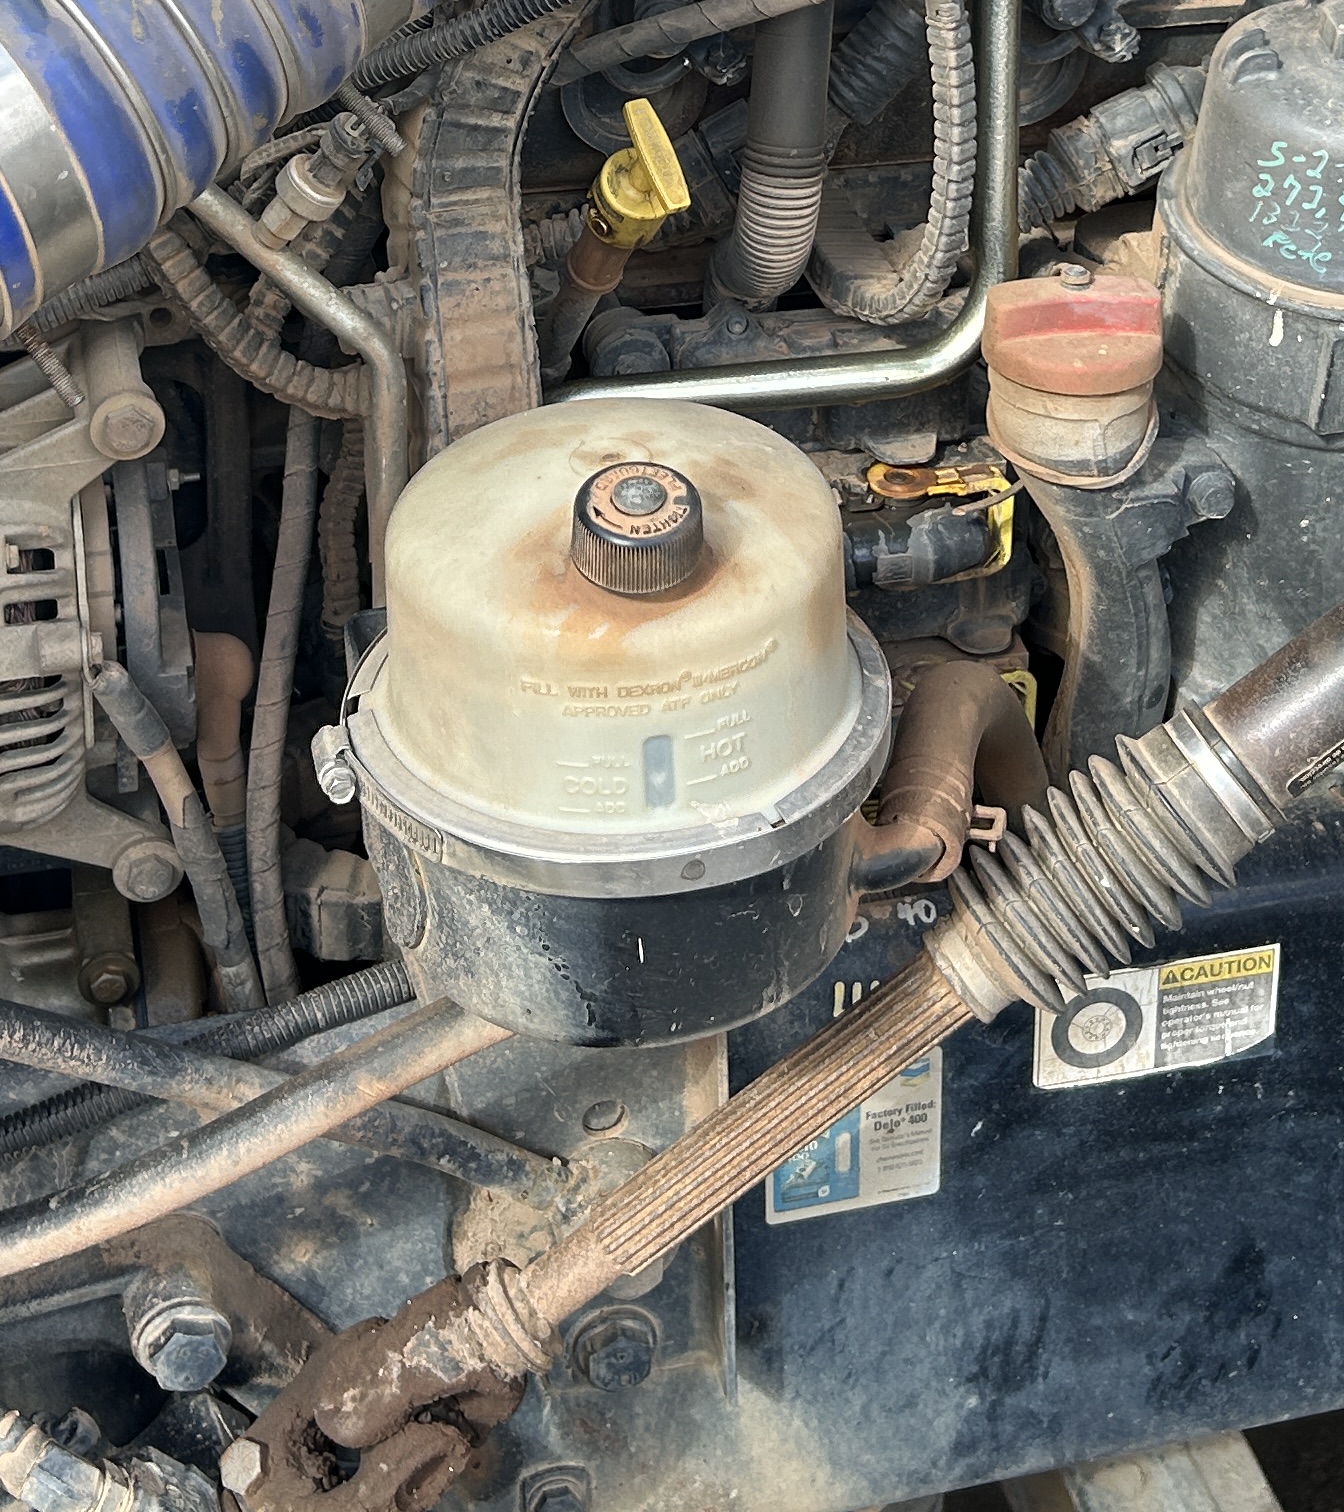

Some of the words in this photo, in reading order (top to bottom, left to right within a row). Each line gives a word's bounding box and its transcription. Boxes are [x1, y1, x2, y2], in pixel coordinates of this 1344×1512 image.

[519, 677, 559, 697] FILL
[567, 685, 609, 699] WITH
[561, 703, 652, 718] APPROVED
[661, 695, 693, 713] ATF
[699, 681, 740, 705] ONLY
[715, 708, 753, 731] FULL
[699, 732, 749, 762] HOT
[718, 755, 752, 777] ADD
[562, 775, 630, 796] COLD
[1180, 954, 1272, 982] CAUTION
[1211, 997, 1230, 1007] See
[1250, 1003, 1265, 1012] for
[865, 1107, 903, 1121] Factory
[905, 1099, 937, 1114] Filled:
[908, 1112, 928, 1125] 400
